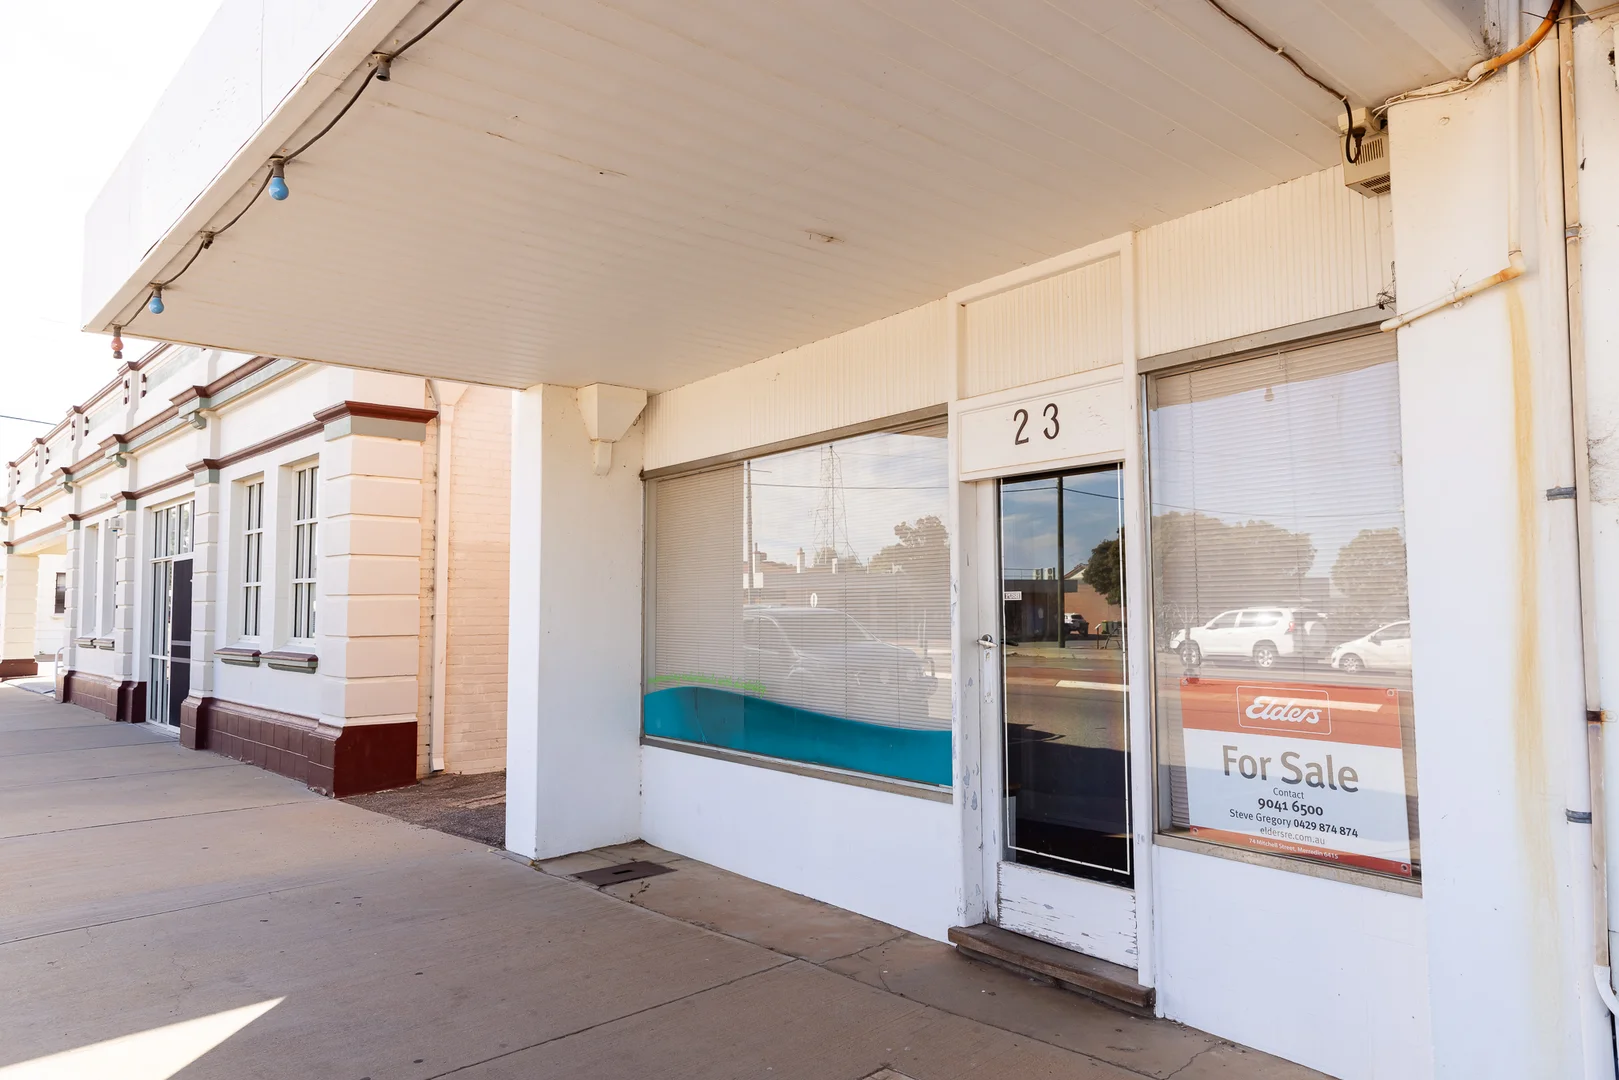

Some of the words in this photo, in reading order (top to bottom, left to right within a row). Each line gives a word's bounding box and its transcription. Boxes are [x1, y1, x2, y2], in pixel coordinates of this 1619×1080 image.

[1013, 402, 1060, 446] 23
[1245, 695, 1322, 724] Elders
[1222, 744, 1271, 781] For
[1280, 751, 1359, 793] Sale
[1273, 787, 1305, 799] Contact
[1258, 798, 1288, 812] 9041
[1292, 800, 1323, 816] 6500
[1229, 808, 1253, 821] Steve
[1256, 813, 1291, 828] Gregory
[1293, 819, 1317, 830] 0429
[1319, 823, 1337, 834] 874
[1340, 826, 1358, 838] 874
[1260, 827, 1325, 845] eldersre.com.au
[1256, 839, 1278, 849] Mitchell
[1297, 847, 1323, 857] Merredin
